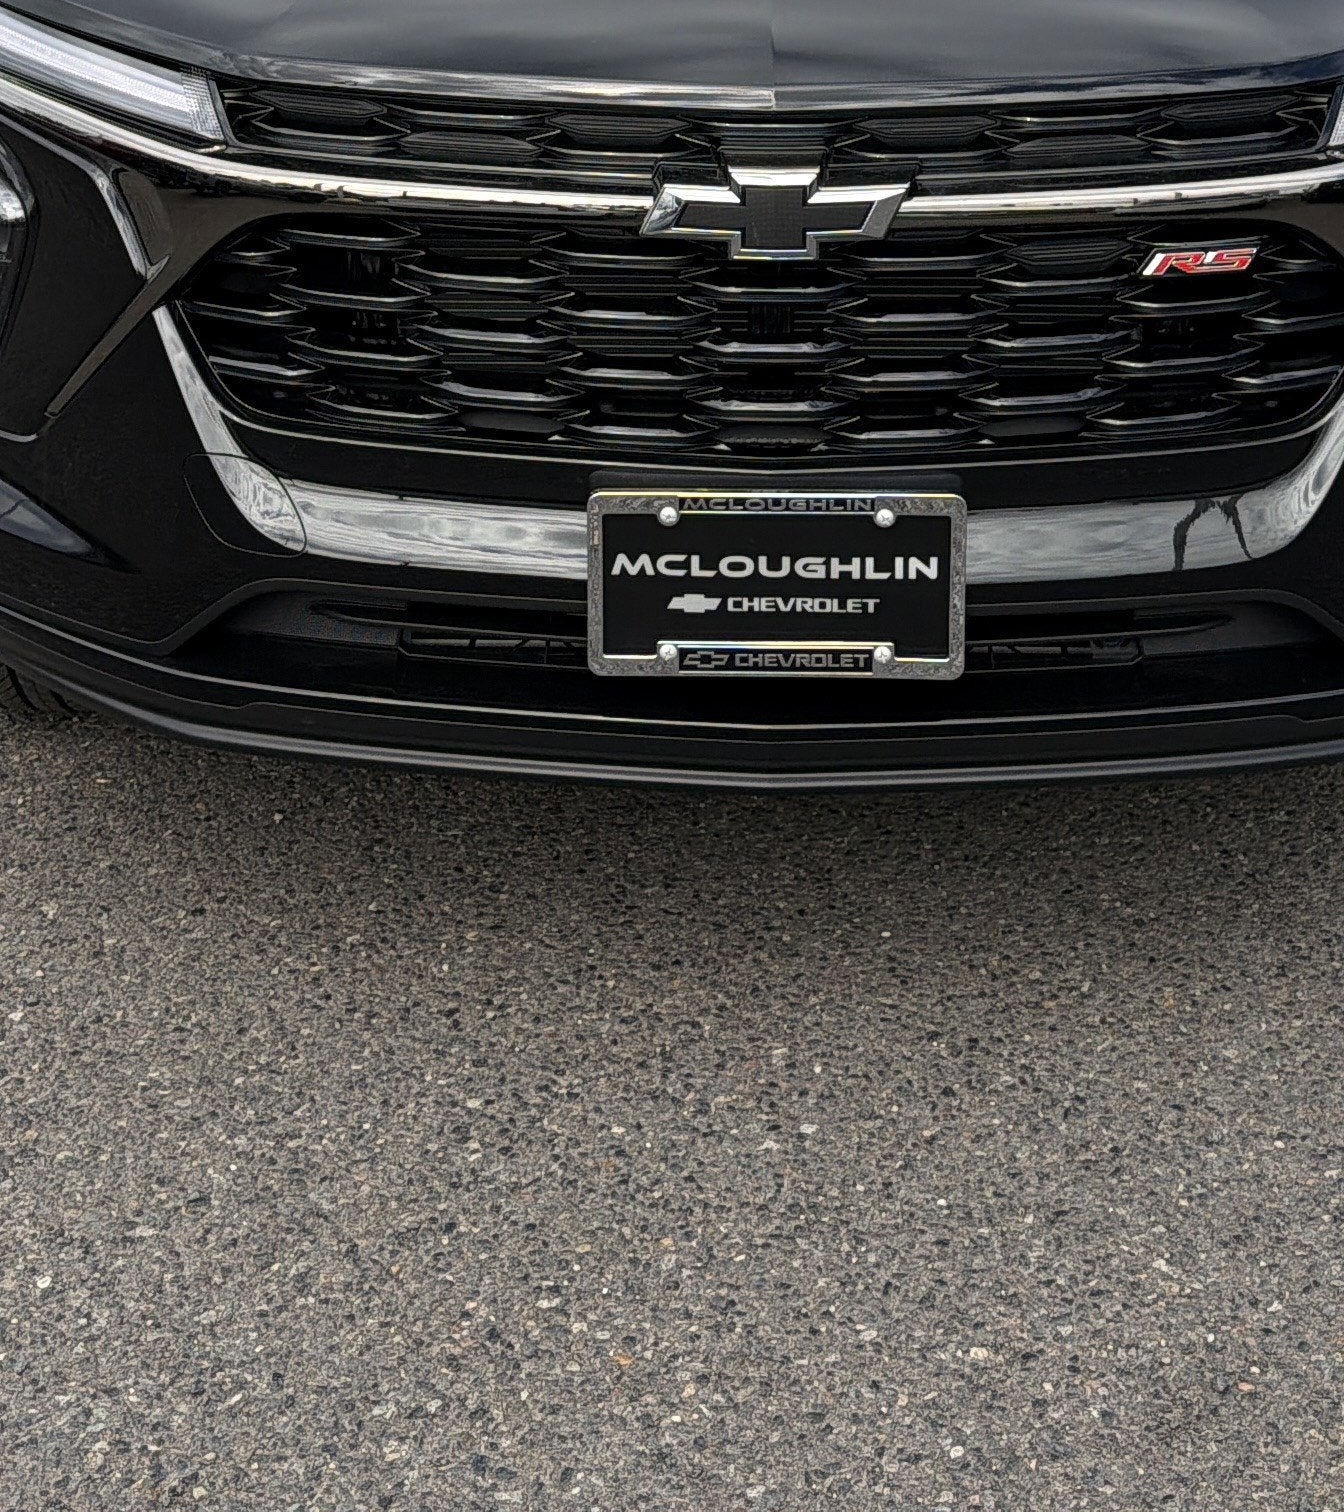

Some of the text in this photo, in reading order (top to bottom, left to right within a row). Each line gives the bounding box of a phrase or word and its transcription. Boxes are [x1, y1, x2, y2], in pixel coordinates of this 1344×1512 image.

[1141, 247, 1258, 276] RS
[683, 497, 873, 512] MCLOUGHLIN
[610, 552, 939, 581] MCLOUGHLIN
[727, 596, 881, 614] CHEVROLET
[734, 652, 870, 669] CHEVROLET
